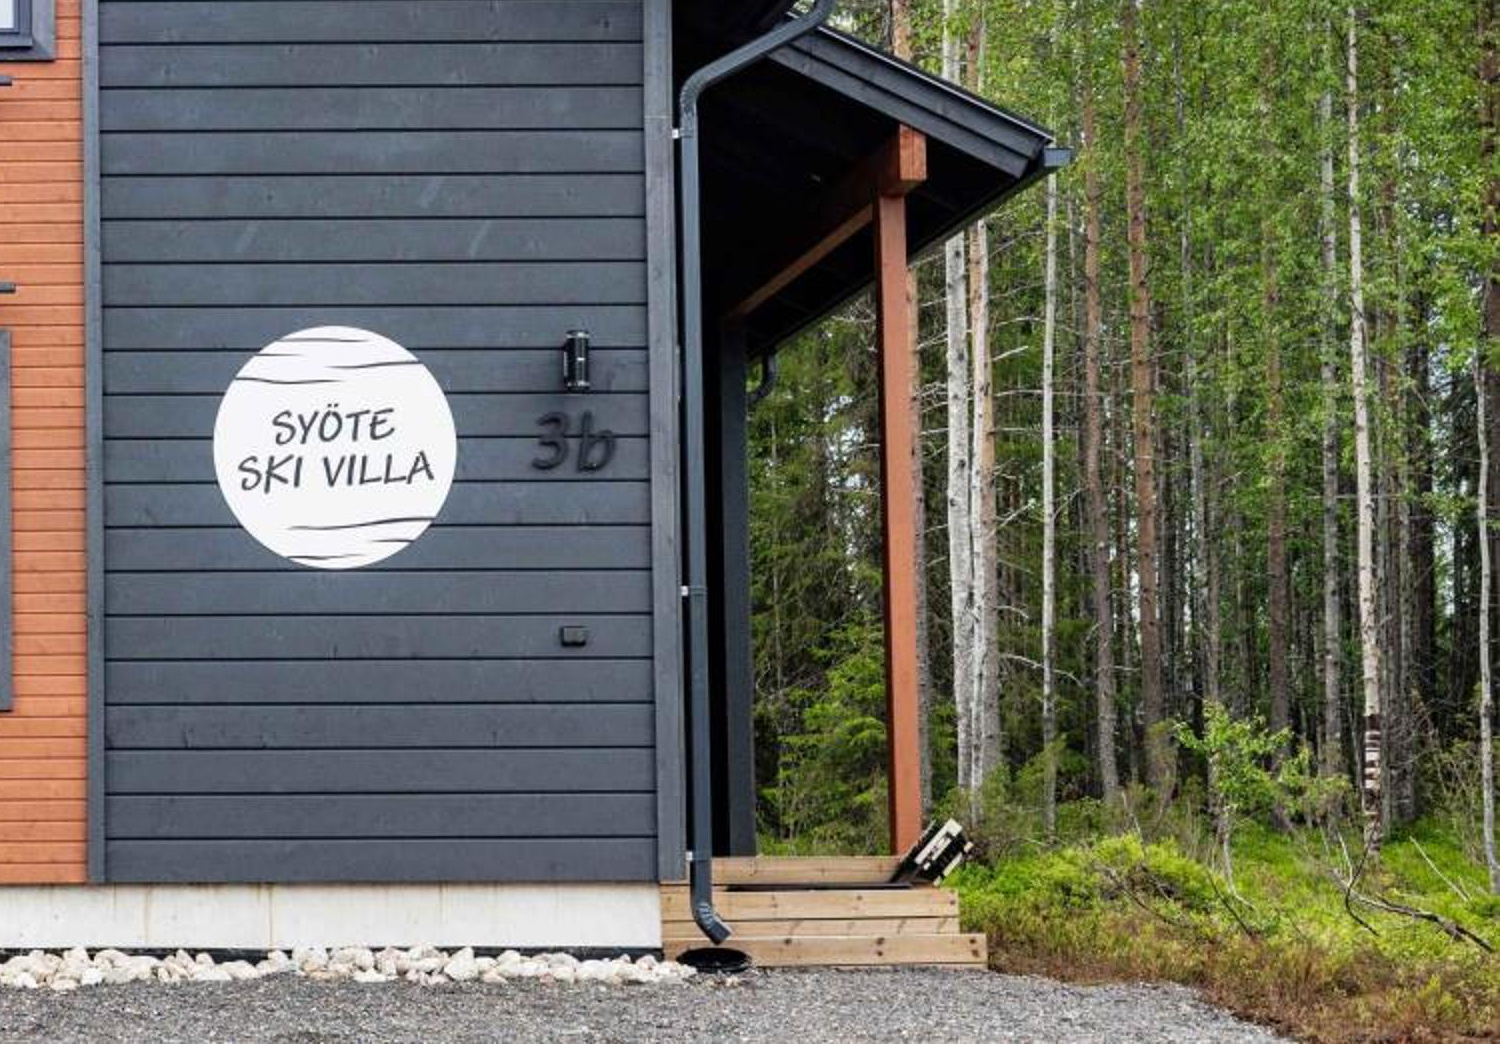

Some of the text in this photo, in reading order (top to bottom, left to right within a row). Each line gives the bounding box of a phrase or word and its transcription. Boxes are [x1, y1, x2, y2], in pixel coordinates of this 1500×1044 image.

[272, 403, 395, 445] SYÖTE
[531, 410, 617, 473] 3b
[238, 451, 435, 494] SKI VILLA
